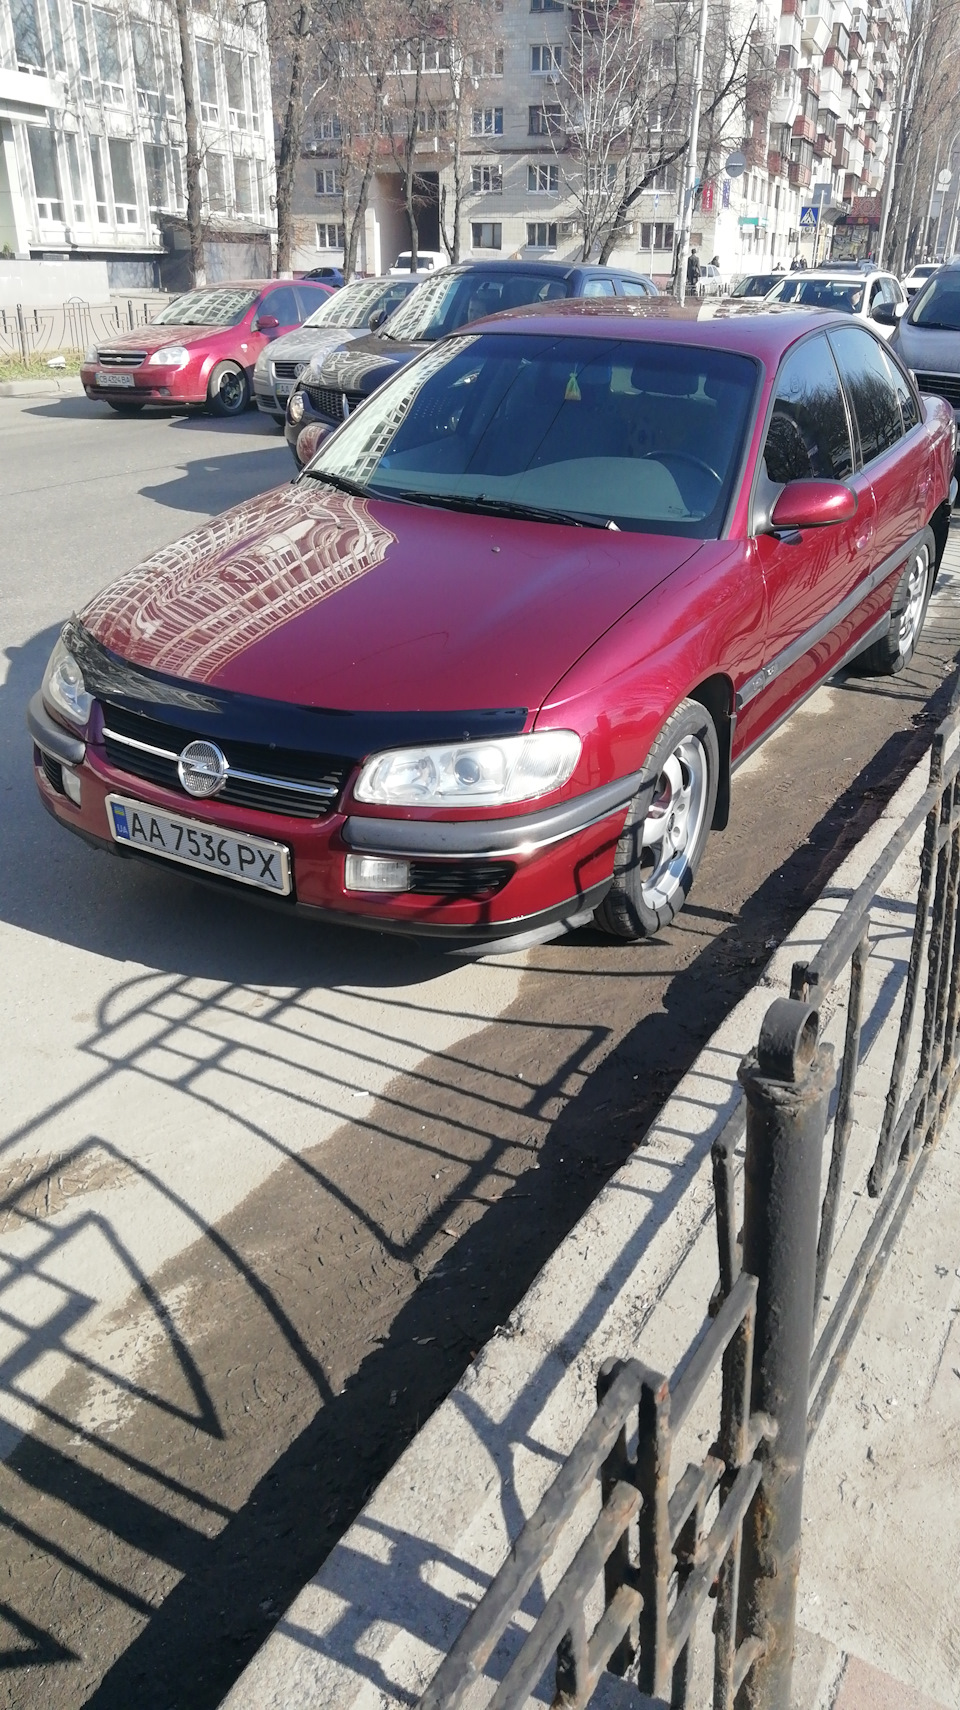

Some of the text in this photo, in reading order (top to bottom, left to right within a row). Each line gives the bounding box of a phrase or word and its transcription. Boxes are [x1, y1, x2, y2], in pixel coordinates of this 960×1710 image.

[116, 823, 129, 835] UA
[131, 812, 278, 882] AA 7536 PX
